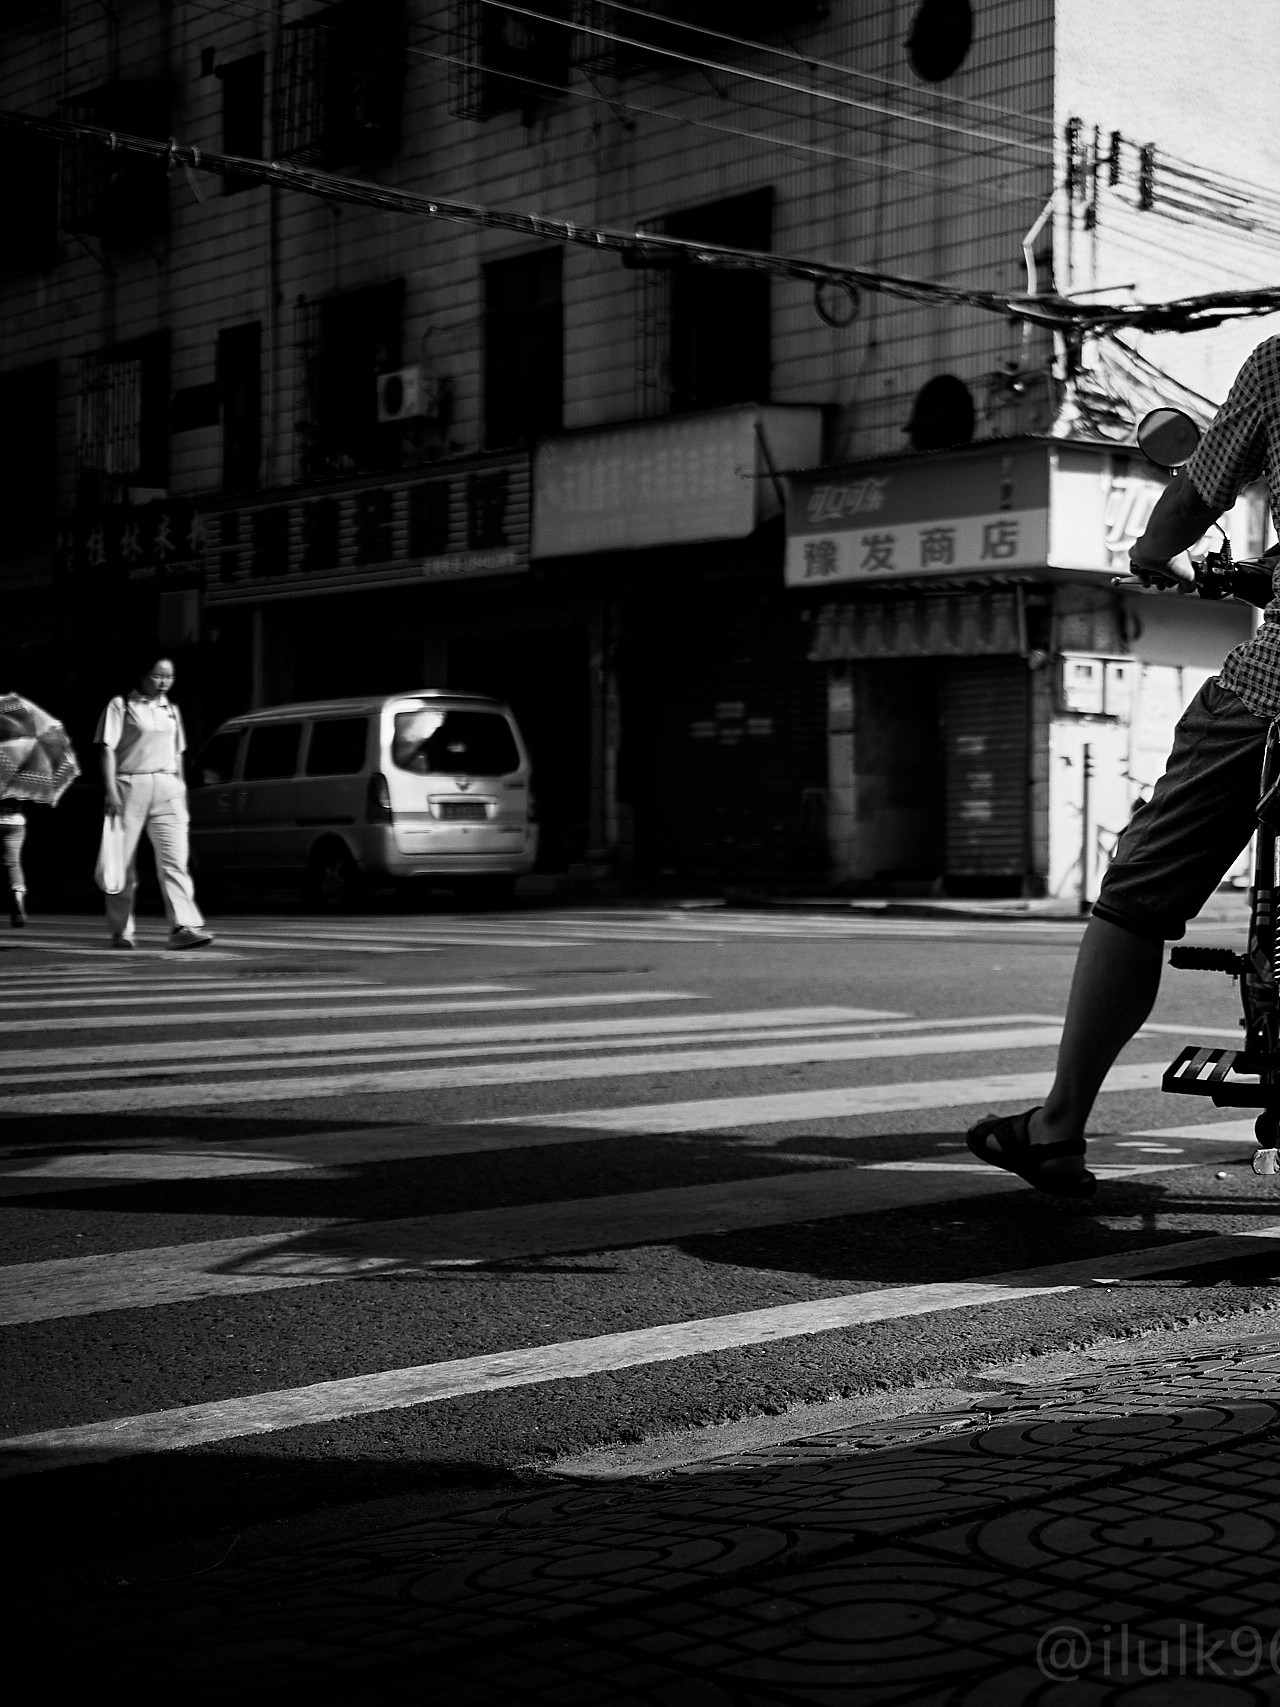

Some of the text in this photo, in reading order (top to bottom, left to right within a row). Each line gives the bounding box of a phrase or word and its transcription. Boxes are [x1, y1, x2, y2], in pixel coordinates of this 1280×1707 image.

[807, 476, 890, 524] 可口可乐
[803, 520, 1018, 579] 豫发商店
